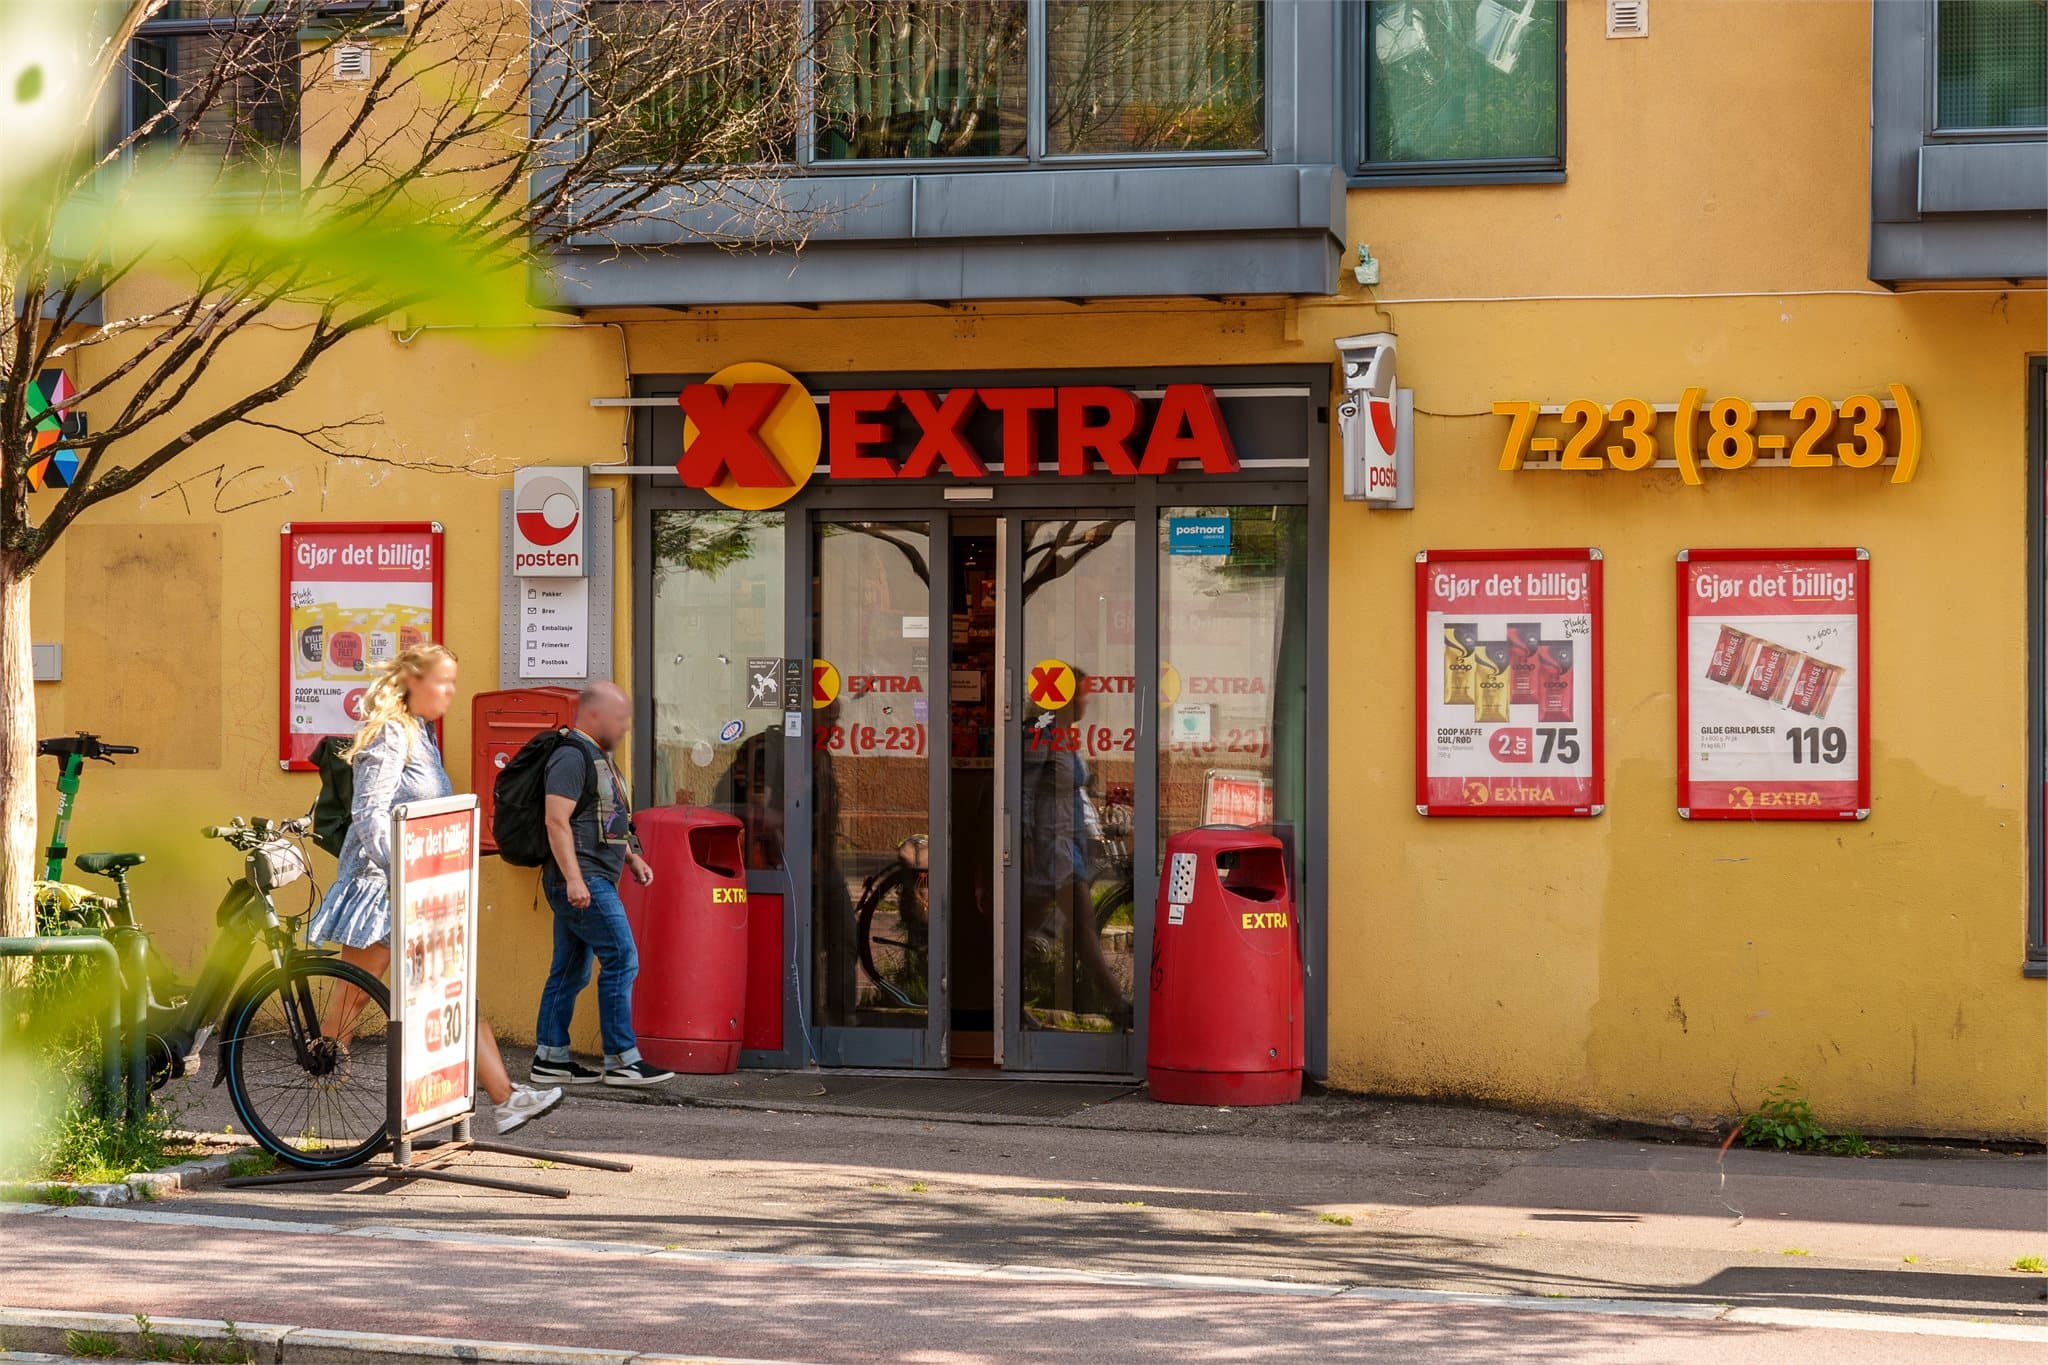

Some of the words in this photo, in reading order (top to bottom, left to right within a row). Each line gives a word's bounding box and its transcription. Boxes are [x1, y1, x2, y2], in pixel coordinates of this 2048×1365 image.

[675, 383, 792, 488] X
[829, 384, 1240, 479] EXTRA
[1493, 397, 1656, 472] 7-23
[1674, 383, 1920, 486] (8-23)
[1176, 525, 1225, 536] postnord
[297, 542, 337, 569] Gjør
[342, 544, 373, 565] det
[378, 543, 431, 570] billig!
[516, 549, 579, 570] posten
[1434, 573, 1480, 602] Gjør
[1485, 574, 1522, 596] det
[1527, 573, 1588, 601] billig!
[1696, 573, 1743, 603] Gjør
[1749, 574, 1787, 597] det
[1792, 573, 1854, 601] billig!
[1562, 615, 1587, 629] Plukk
[295, 687, 313, 695] COOP
[314, 688, 344, 696] KYLLING-
[848, 675, 924, 692] EXTRA
[1189, 677, 1266, 694] EXTRA
[850, 723, 926, 756] (8-23)
[1028, 727, 1082, 752] 7-23
[1437, 728, 1459, 736] COOP
[1459, 728, 1483, 736] KAFFE
[1437, 736, 1472, 744] GUL/RØD
[1701, 726, 1723, 734] GILDE
[1724, 726, 1776, 735] GRILLPØLSER
[1498, 734, 1510, 755] 2
[1513, 735, 1527, 755] for
[1535, 727, 1581, 764] 75
[1786, 726, 1847, 764] 119
[1494, 787, 1556, 801] EXTRA
[1760, 792, 1822, 806] EXTRA
[1242, 913, 1288, 929] EXTRA
[444, 1001, 461, 1047] 30
